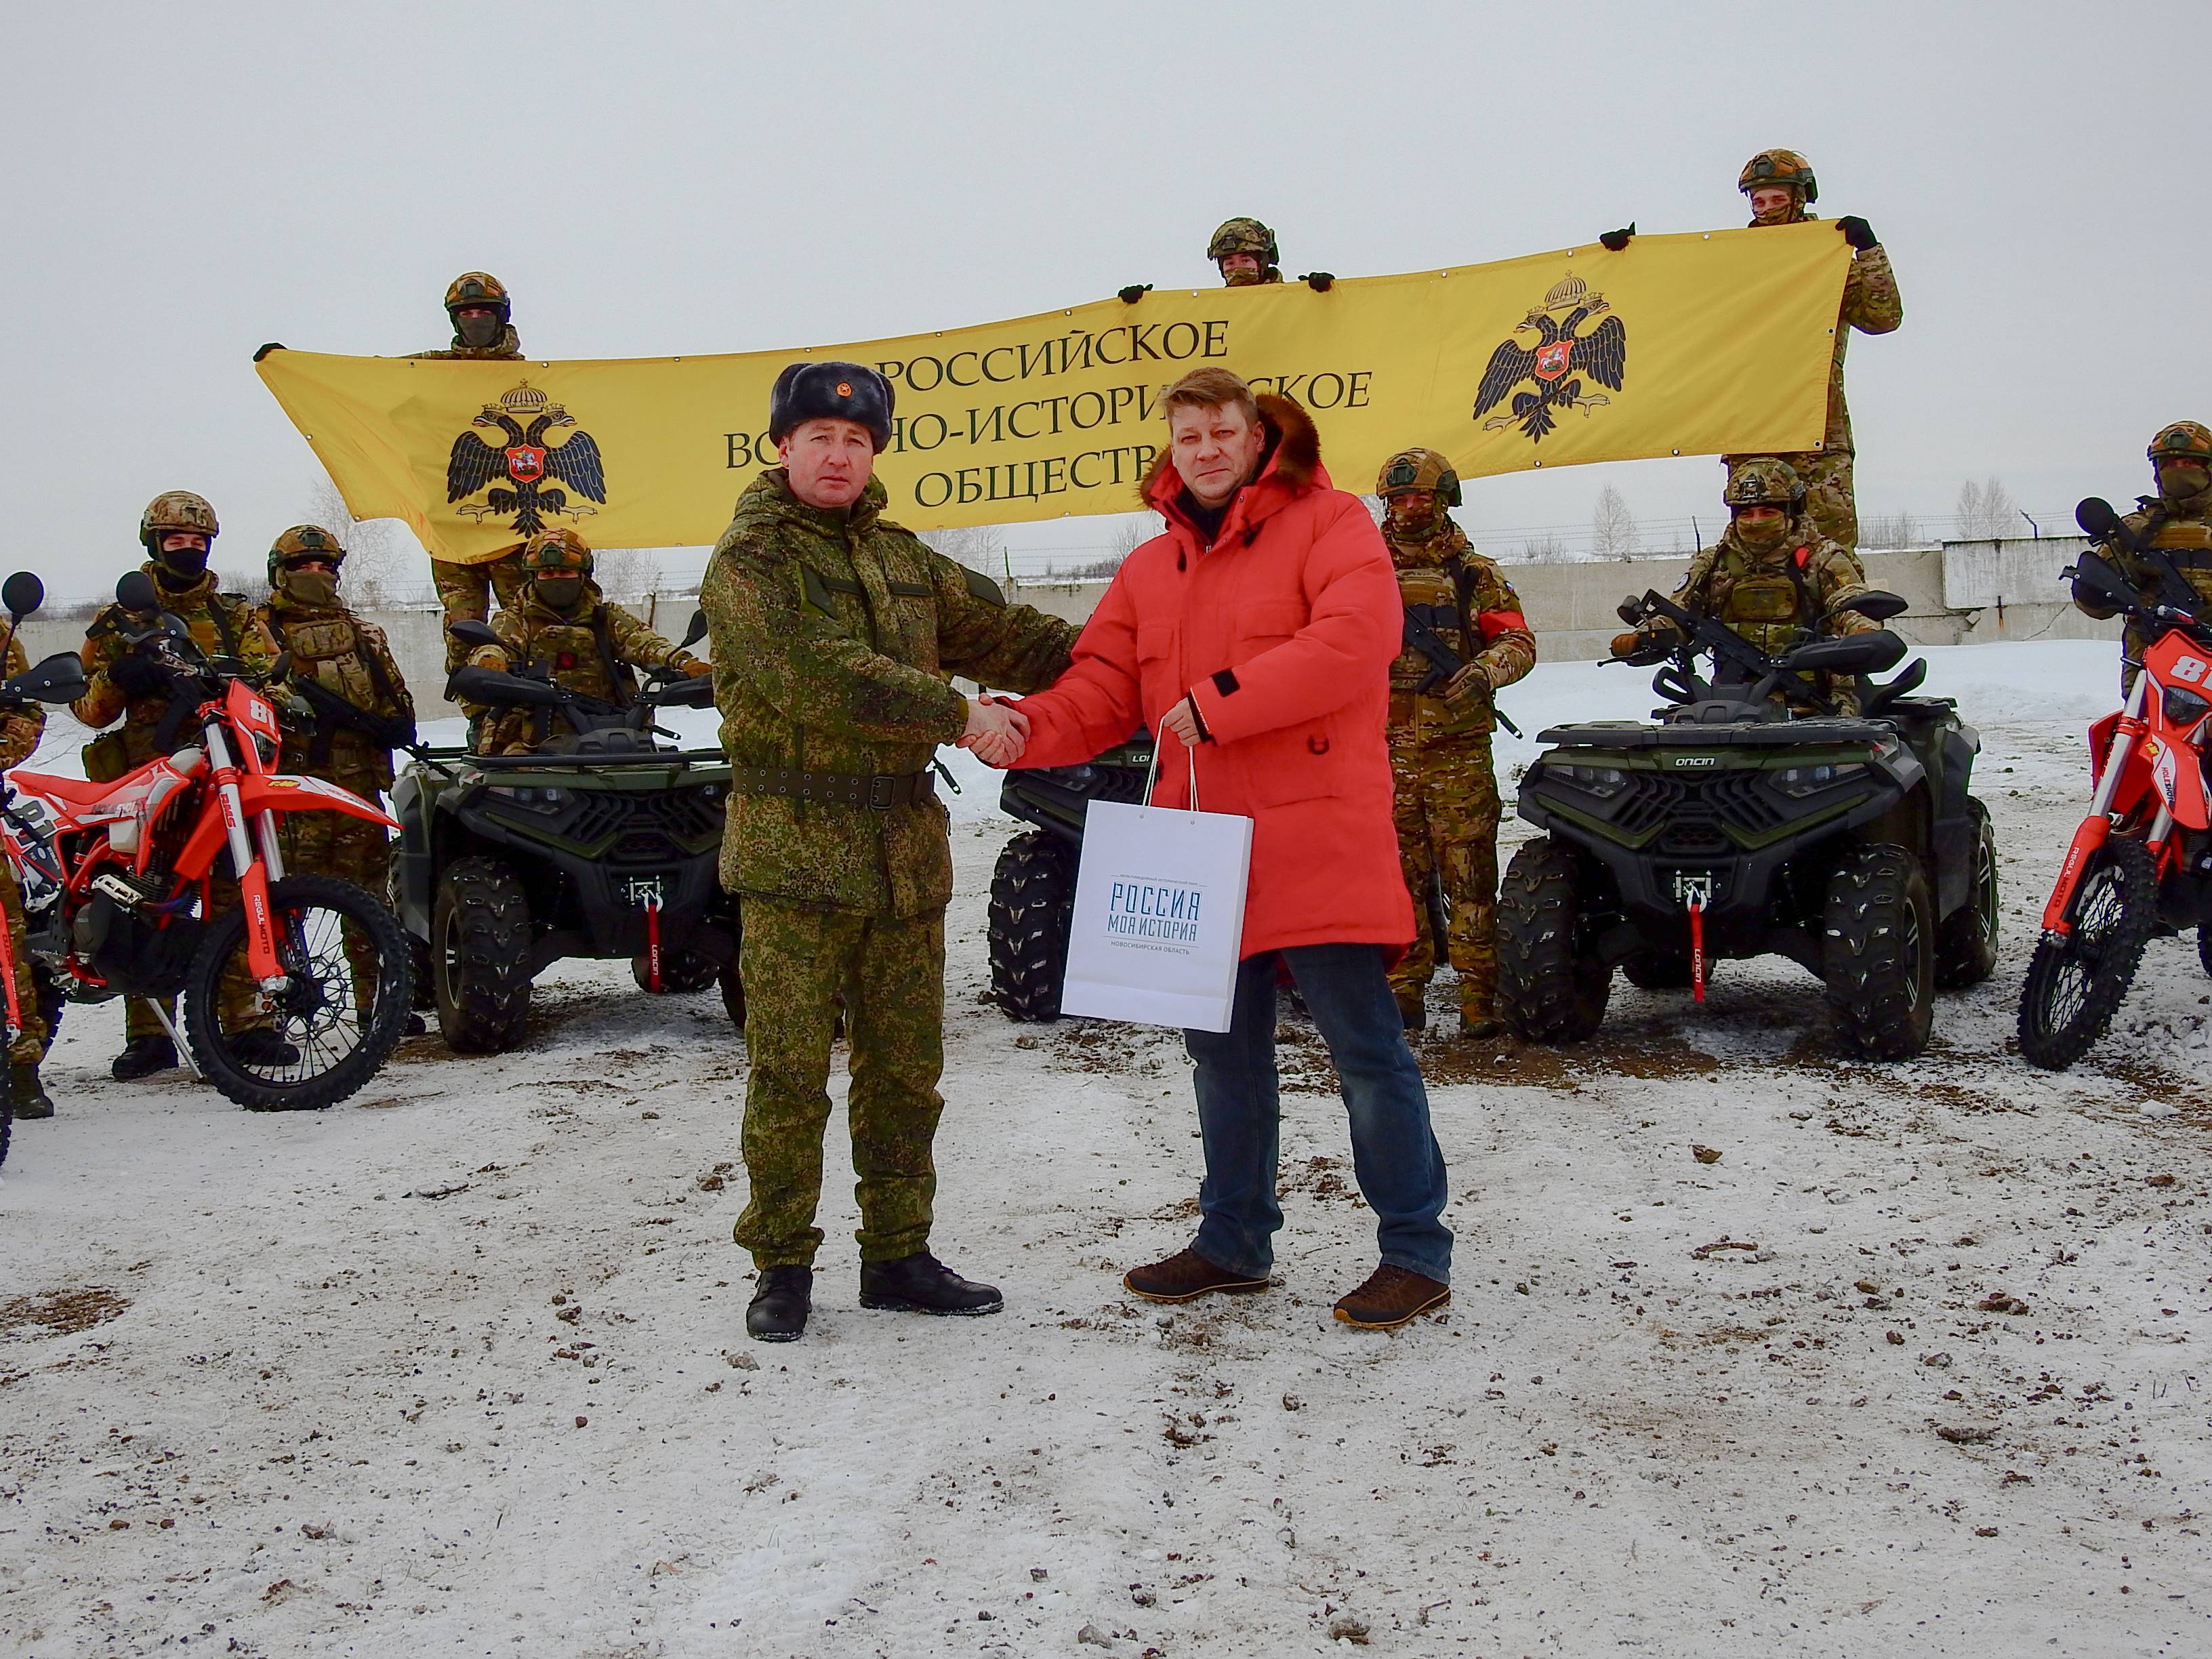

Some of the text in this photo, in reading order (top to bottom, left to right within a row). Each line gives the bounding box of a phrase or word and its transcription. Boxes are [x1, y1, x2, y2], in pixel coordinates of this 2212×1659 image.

[875, 320, 1229, 392] РОССИЙСКОЕ
[915, 444, 1157, 508] ОБЩЕСТВ
[250, 699, 276, 731] 81
[1111, 881, 1201, 921] РОССИЯ
[253, 895, 270, 954] REGULMOTO
[1107, 914, 1197, 942] МОЯ ИСТОРИЯ
[1111, 940, 1190, 955] НОВОСИБИРСКАЯ ОБЛАСТЬ
